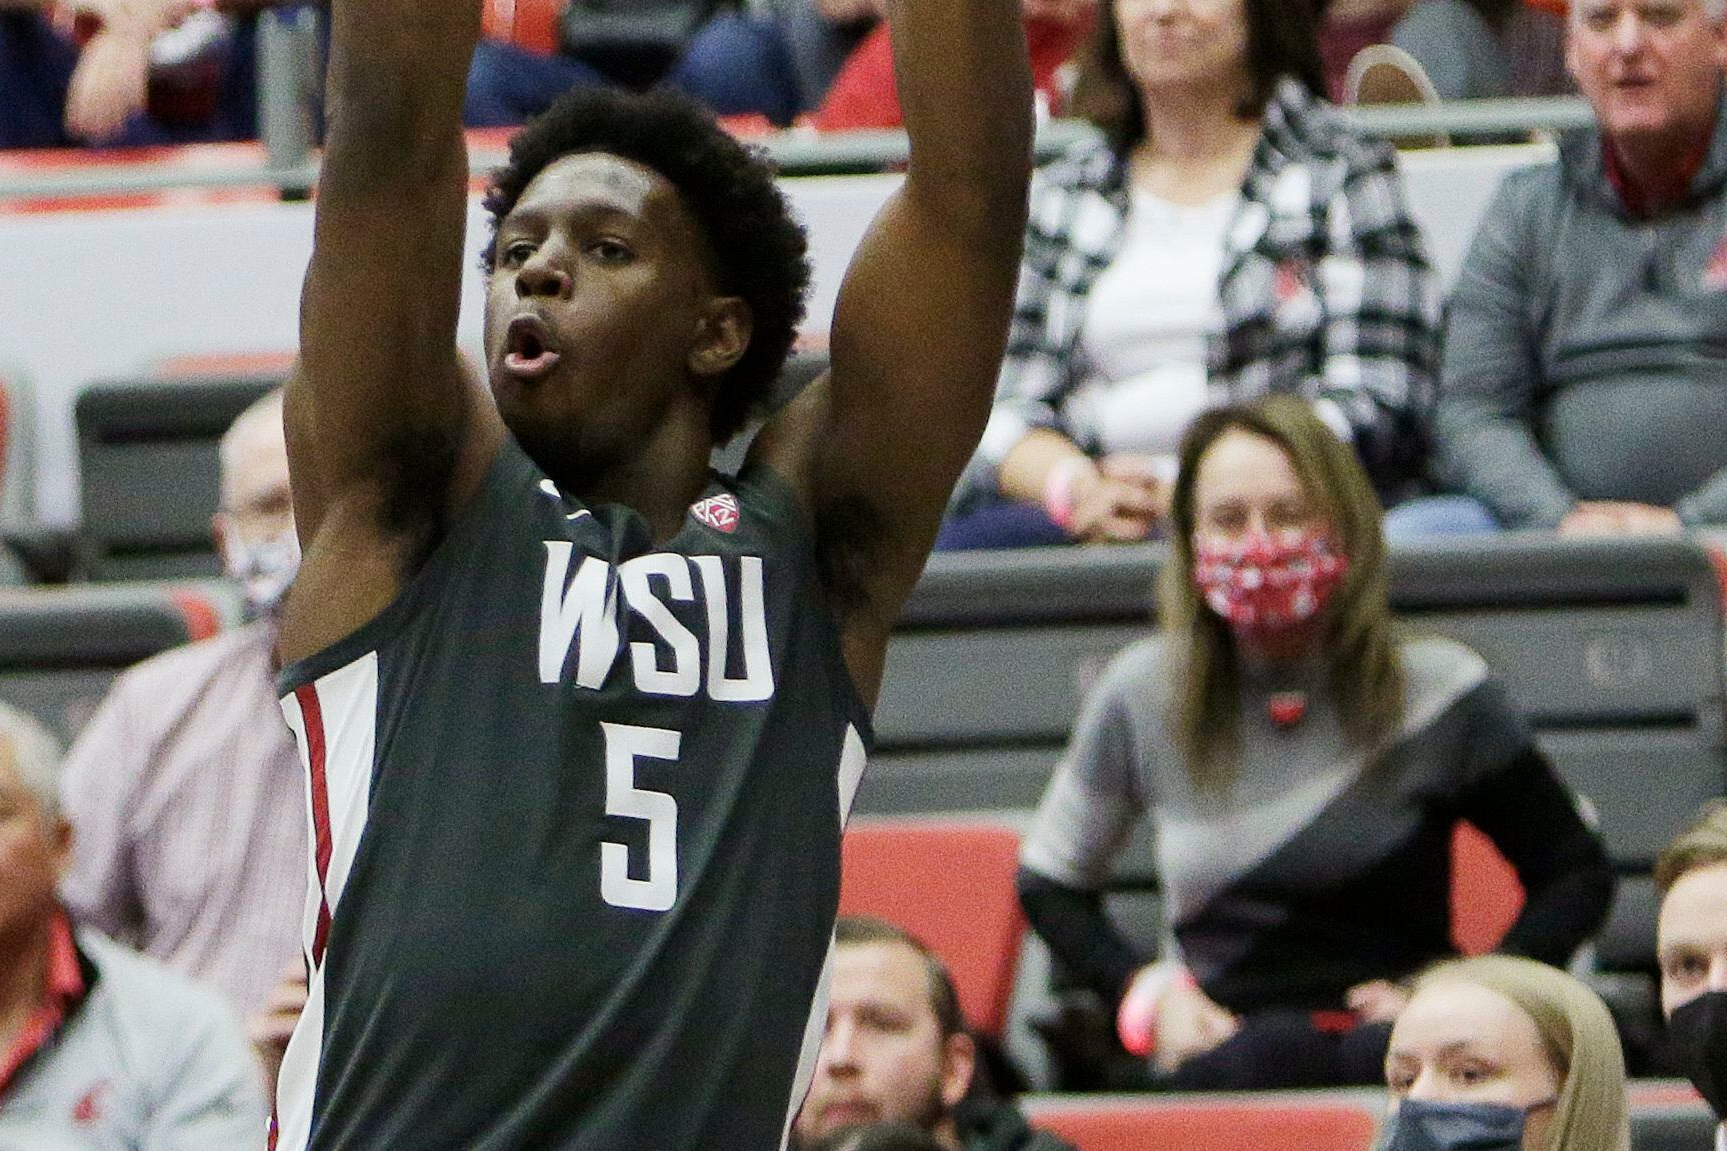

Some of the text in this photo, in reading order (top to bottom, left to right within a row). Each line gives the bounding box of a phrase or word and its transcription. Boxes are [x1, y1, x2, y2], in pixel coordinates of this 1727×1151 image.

[690, 493, 737, 522] PAC
[539, 541, 775, 701] WSU
[600, 721, 681, 911] 5
